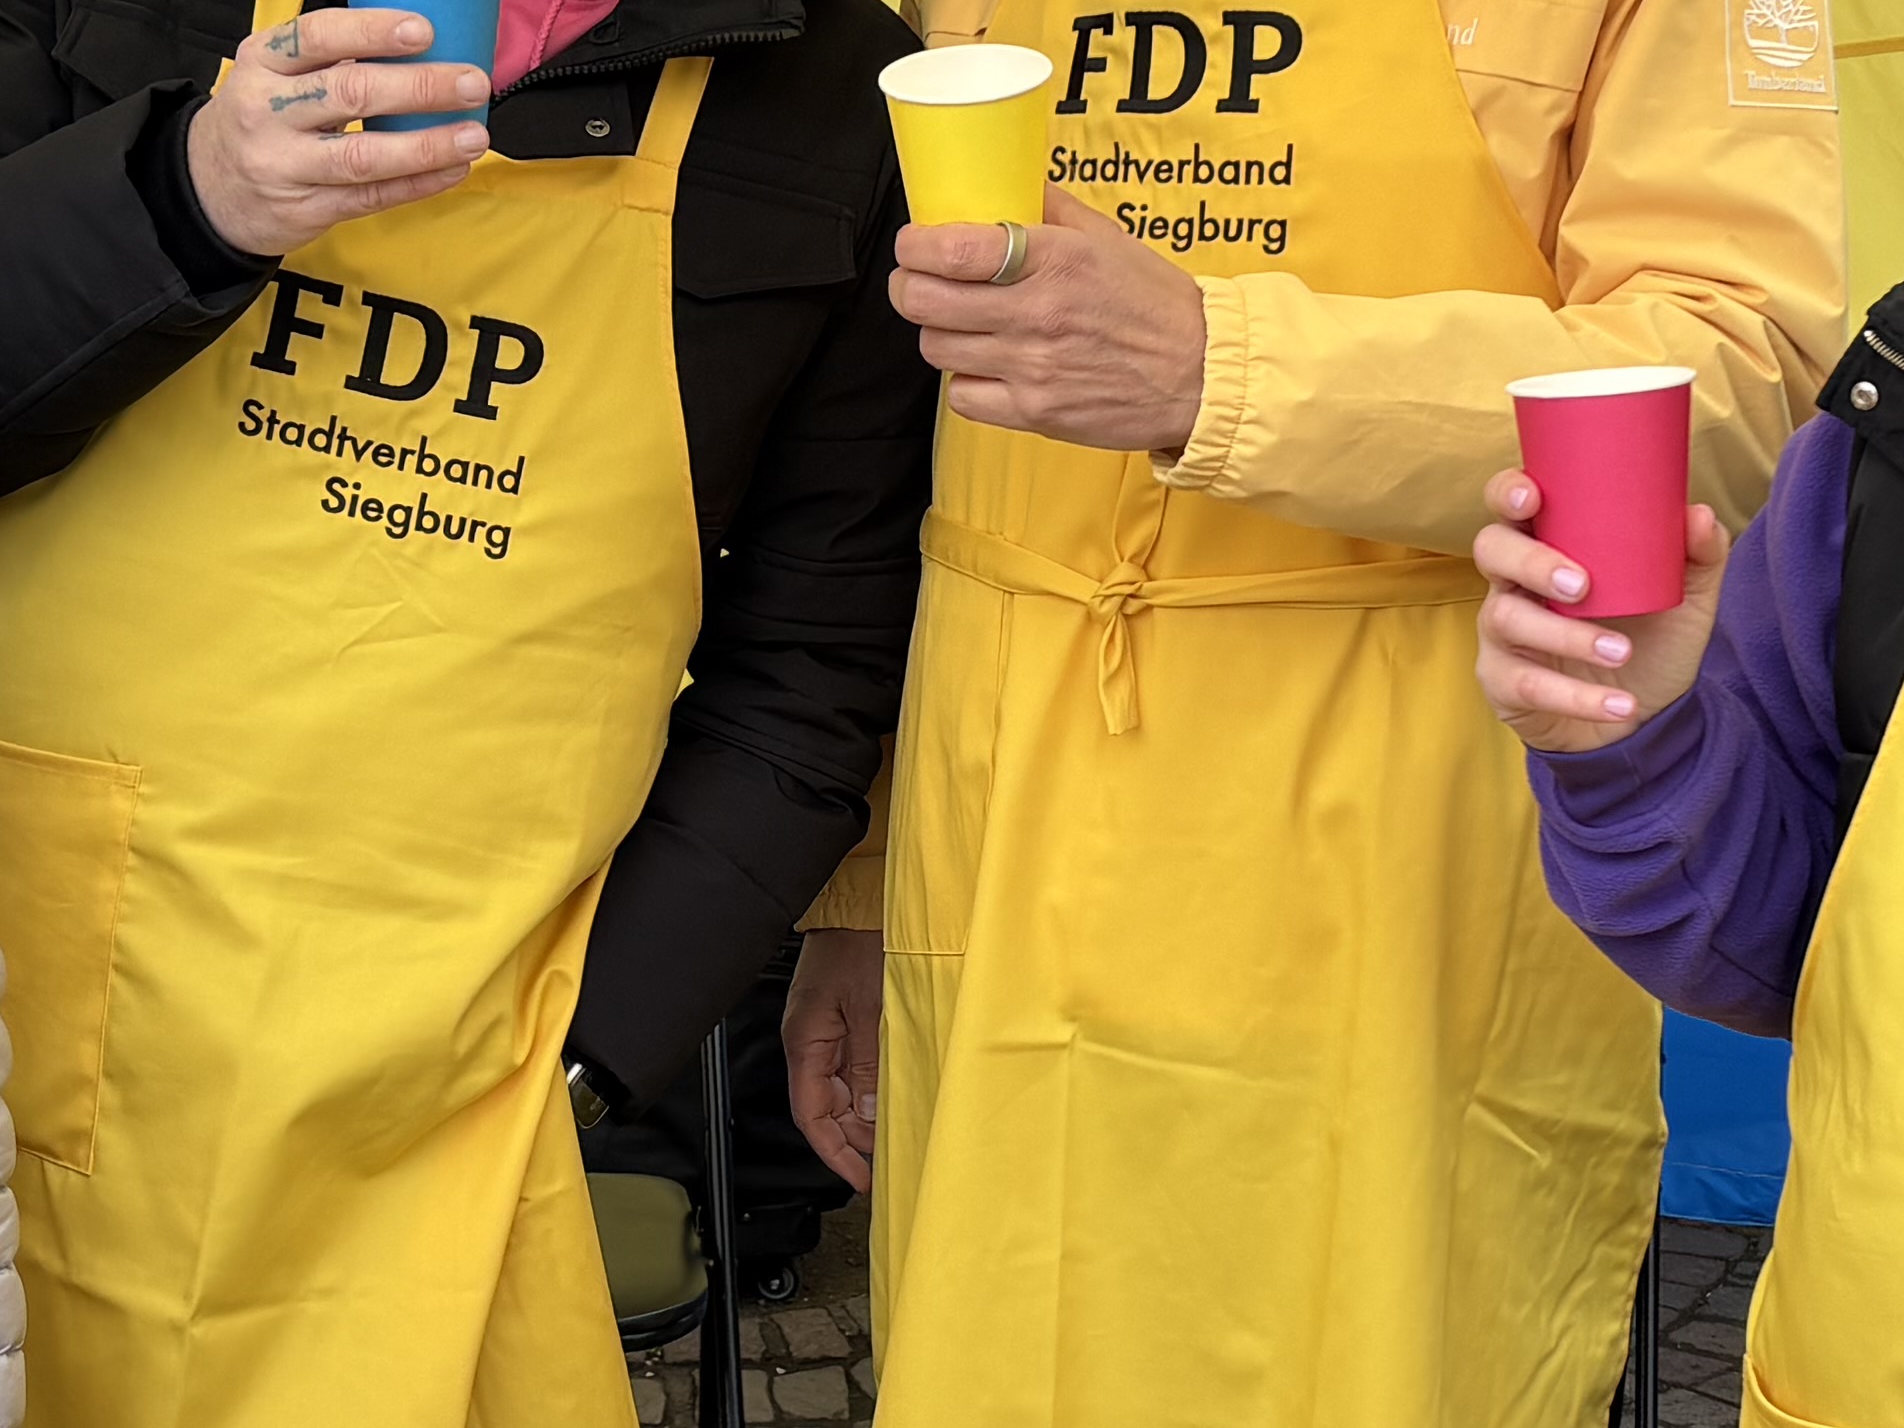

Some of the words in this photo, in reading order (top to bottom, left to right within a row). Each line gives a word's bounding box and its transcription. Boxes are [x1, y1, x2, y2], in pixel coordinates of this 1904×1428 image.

[1054, 9, 1304, 116] FDP
[1047, 141, 1295, 187] Stadtverband
[1115, 200, 1289, 256] Siegburg
[249, 267, 545, 421] FDP
[237, 398, 526, 496] Stadtverband
[320, 475, 512, 561] Siegburg
